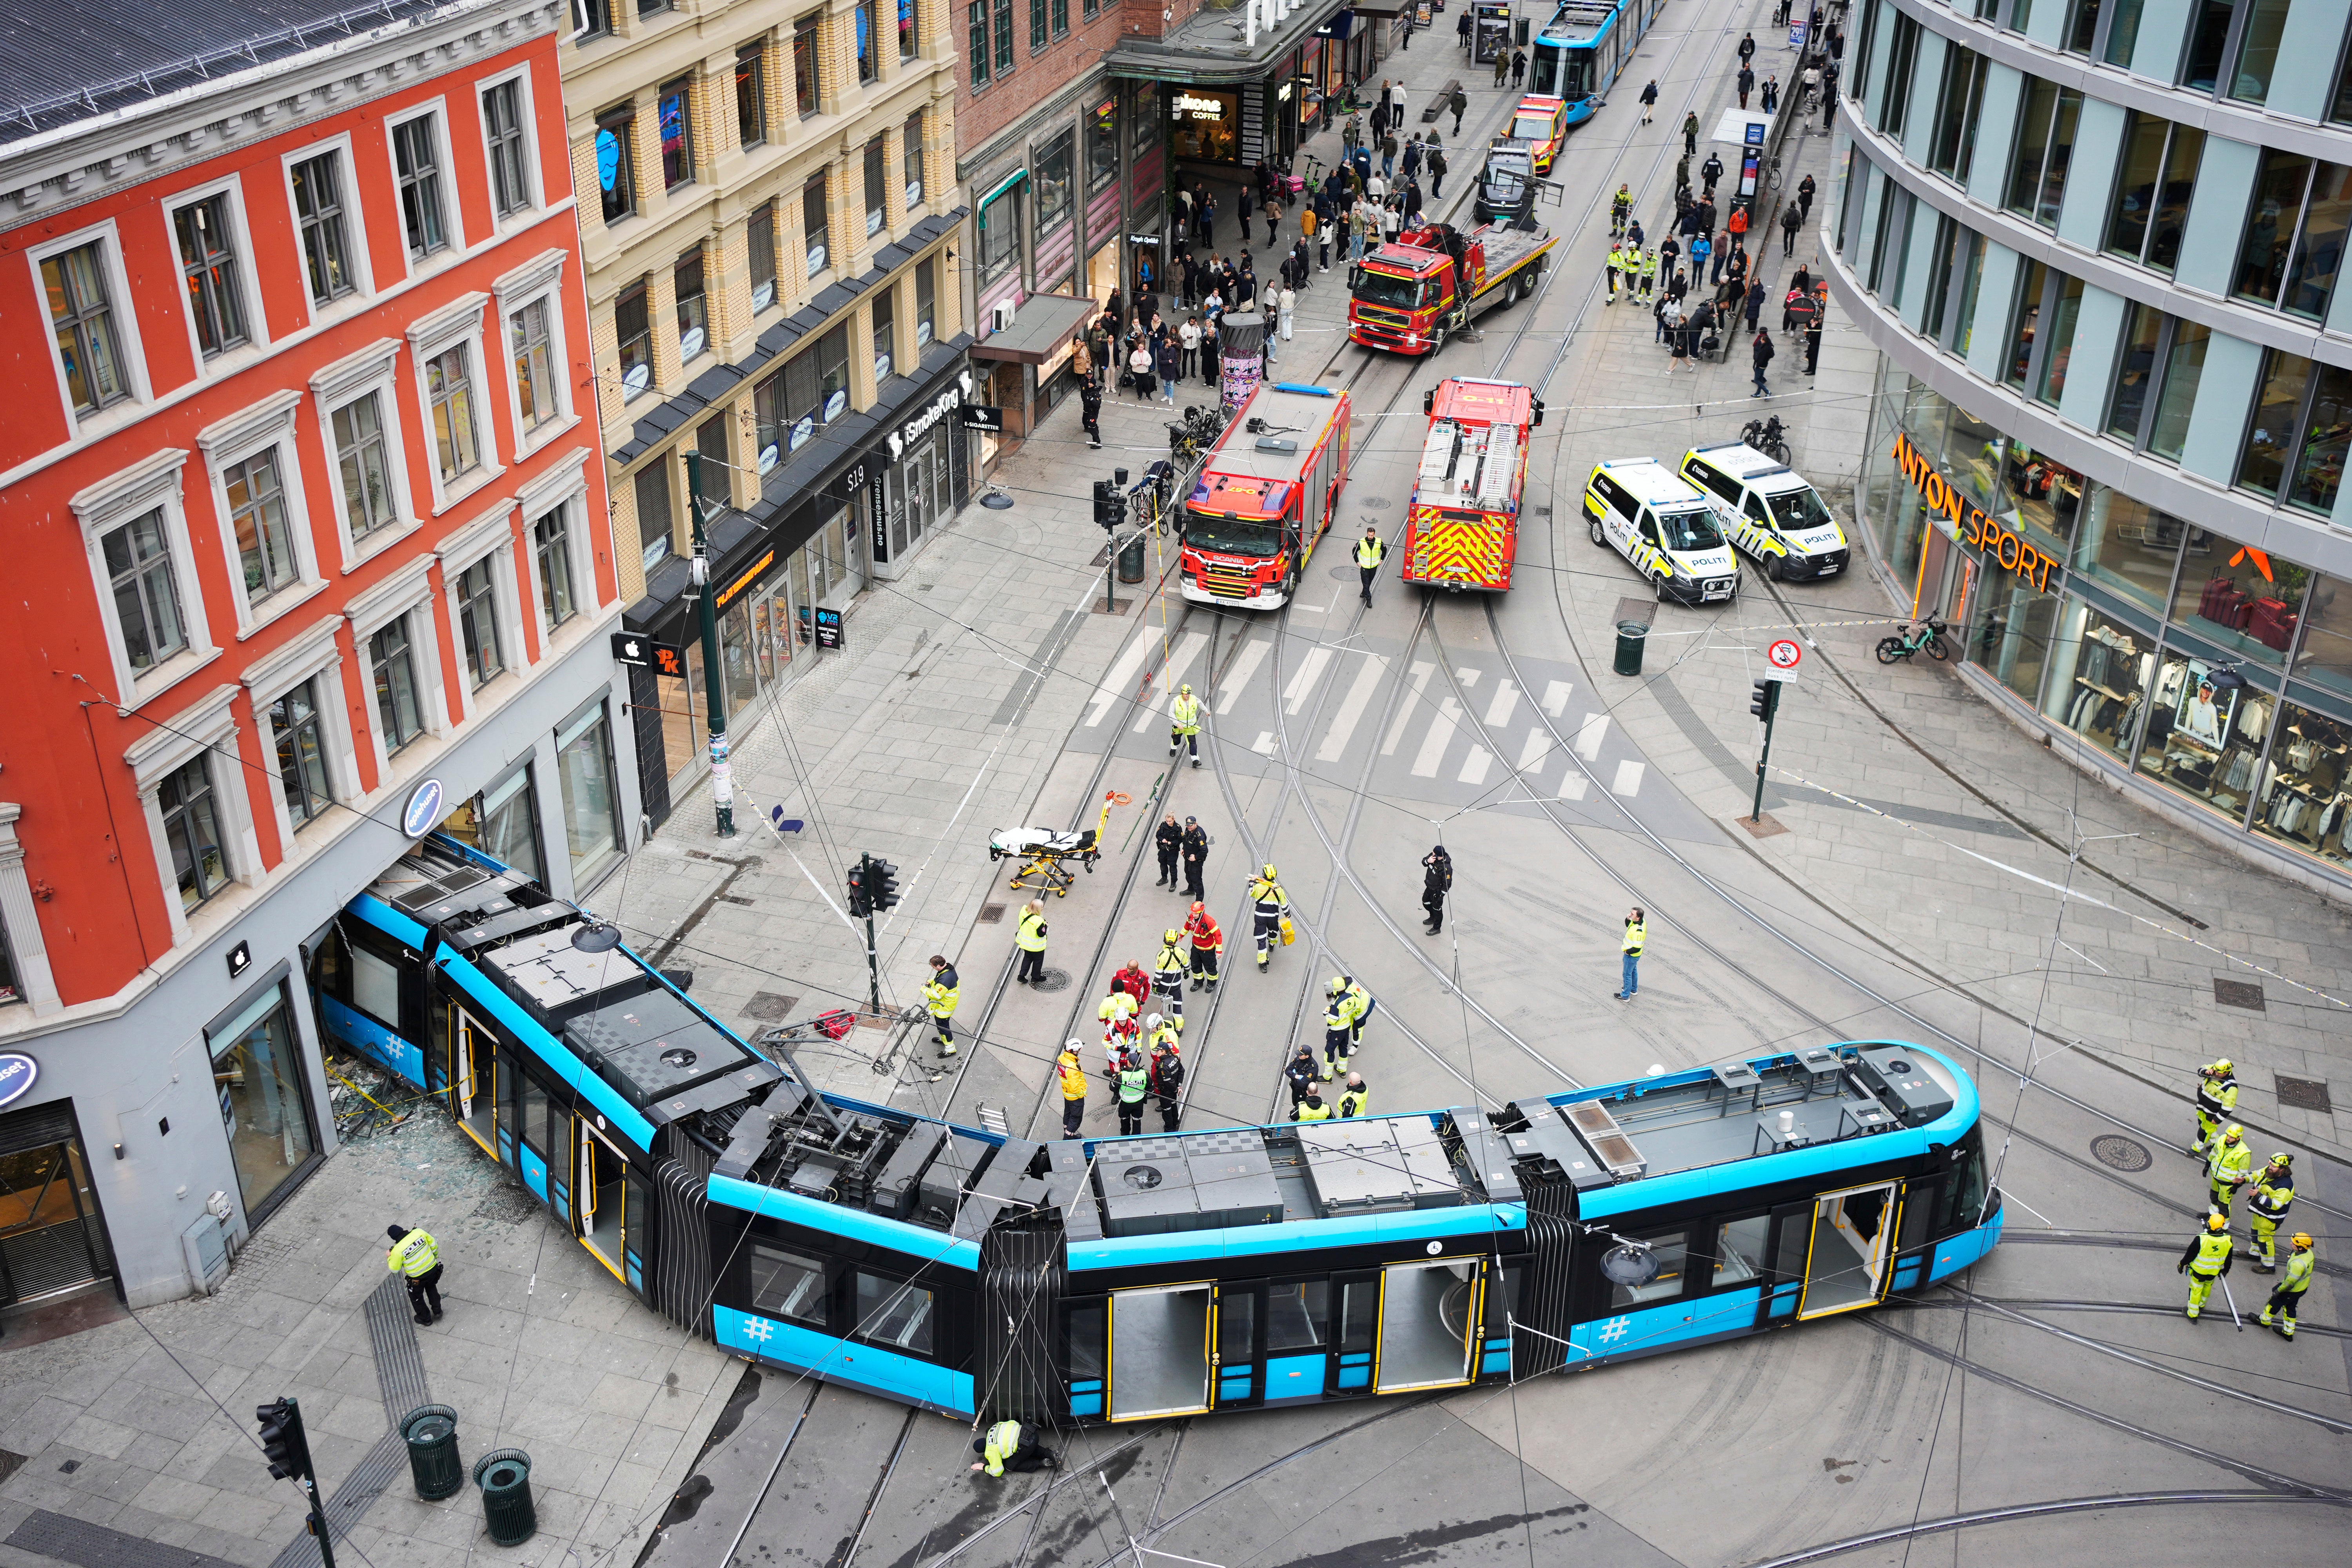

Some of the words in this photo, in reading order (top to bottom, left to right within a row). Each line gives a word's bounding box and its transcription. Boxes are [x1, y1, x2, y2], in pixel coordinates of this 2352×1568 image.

[1192, 111, 1220, 121] COFFEE
[662, 135, 684, 156] ONE
[1130, 235, 1144, 244] Krogh
[753, 286, 771, 299] Tolketjenesten
[683, 332, 702, 347] Tolketjenesten
[876, 361, 889, 373] rettshjelp
[626, 370, 647, 385] Tolketjenesten
[831, 397, 844, 412] rettshjelp
[1463, 395, 1504, 404] O-11
[905, 388, 958, 445] iSmokeKing
[964, 421, 999, 431] E-SIGARETTER
[1339, 421, 1350, 450] O-67
[761, 451, 777, 467] rettshjelp
[848, 465, 863, 492] S19
[1695, 466, 1708, 479] 02800
[1601, 482, 1612, 494] 02800
[875, 477, 884, 546] Grensesnus.no
[1892, 432, 1964, 529] ANTON
[1967, 509, 2058, 593] SPORT
[1610, 522, 1628, 544] POLITI
[1804, 534, 1837, 544] POLITI
[648, 541, 666, 557] rettshjelp
[1437, 534, 1486, 554] O-11
[1213, 555, 1245, 564] SCANIA
[1691, 557, 1727, 566] POLITI
[827, 613, 838, 621] VR
[409, 785, 438, 828] eplehuset
[403, 1236, 425, 1257] POLITI
